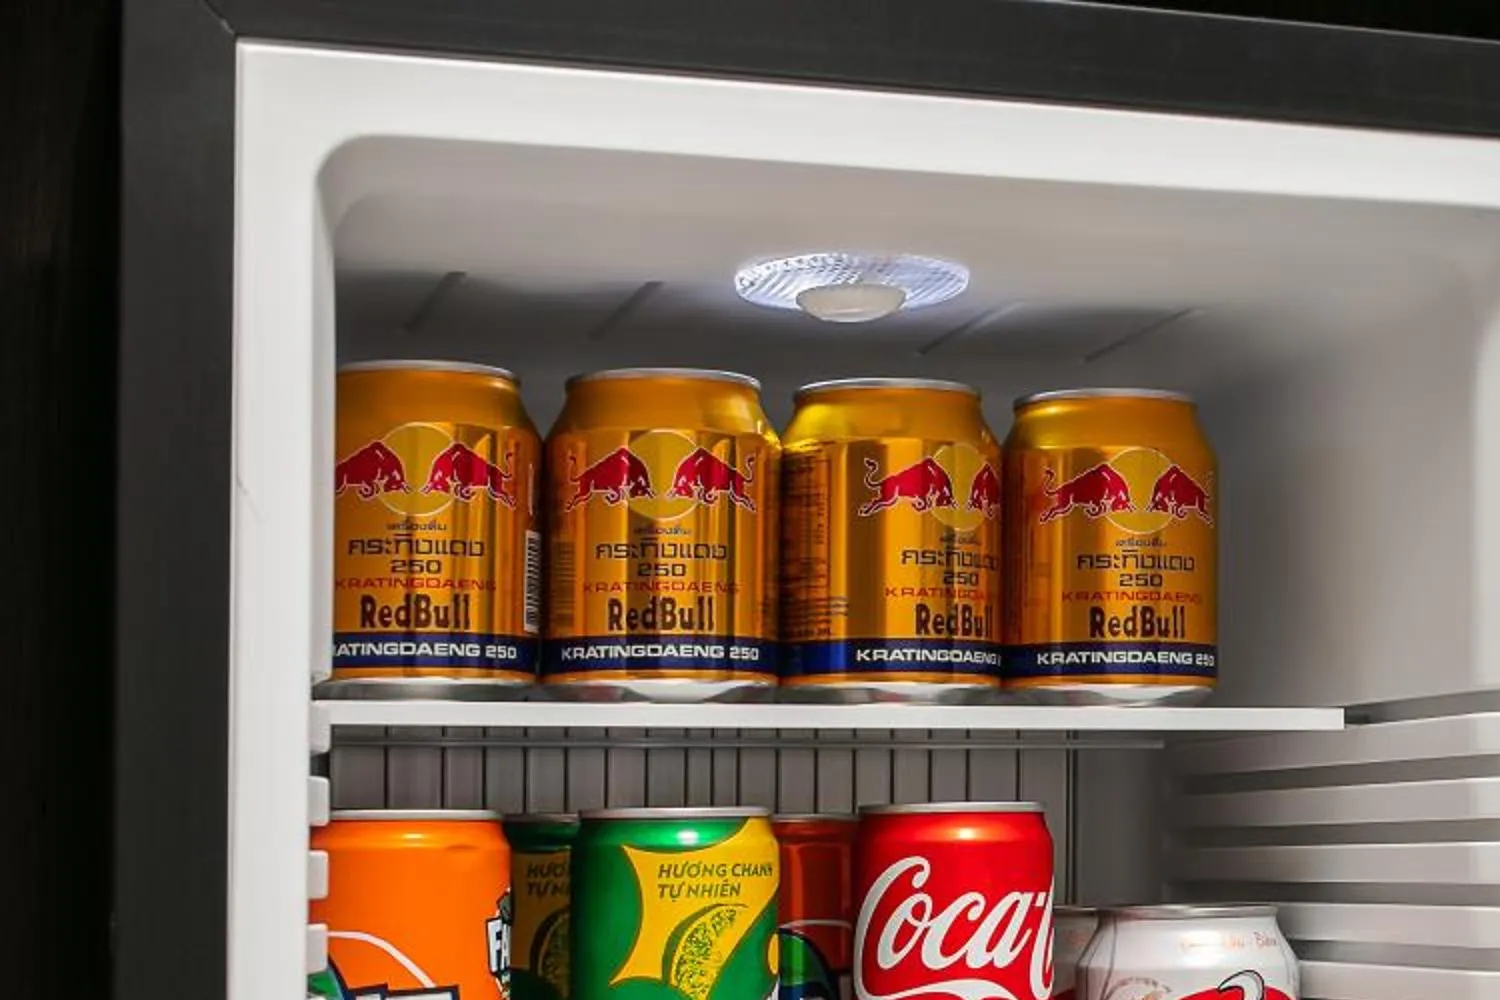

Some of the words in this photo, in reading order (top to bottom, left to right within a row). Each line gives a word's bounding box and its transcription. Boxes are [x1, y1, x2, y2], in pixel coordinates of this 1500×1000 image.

[391, 560, 441, 574] 250
[638, 563, 686, 577] 250
[944, 572, 978, 586] 250
[1119, 573, 1163, 588] 250
[360, 592, 470, 630] RedBull
[608, 596, 714, 631] RedBull
[1089, 605, 1185, 639] RedBull
[334, 642, 480, 657] ATINGDAENG
[485, 645, 517, 659] 250
[561, 645, 724, 660] KRATINGDAENG
[729, 647, 759, 661] 250
[1037, 651, 1192, 665] KRATINGDAENG
